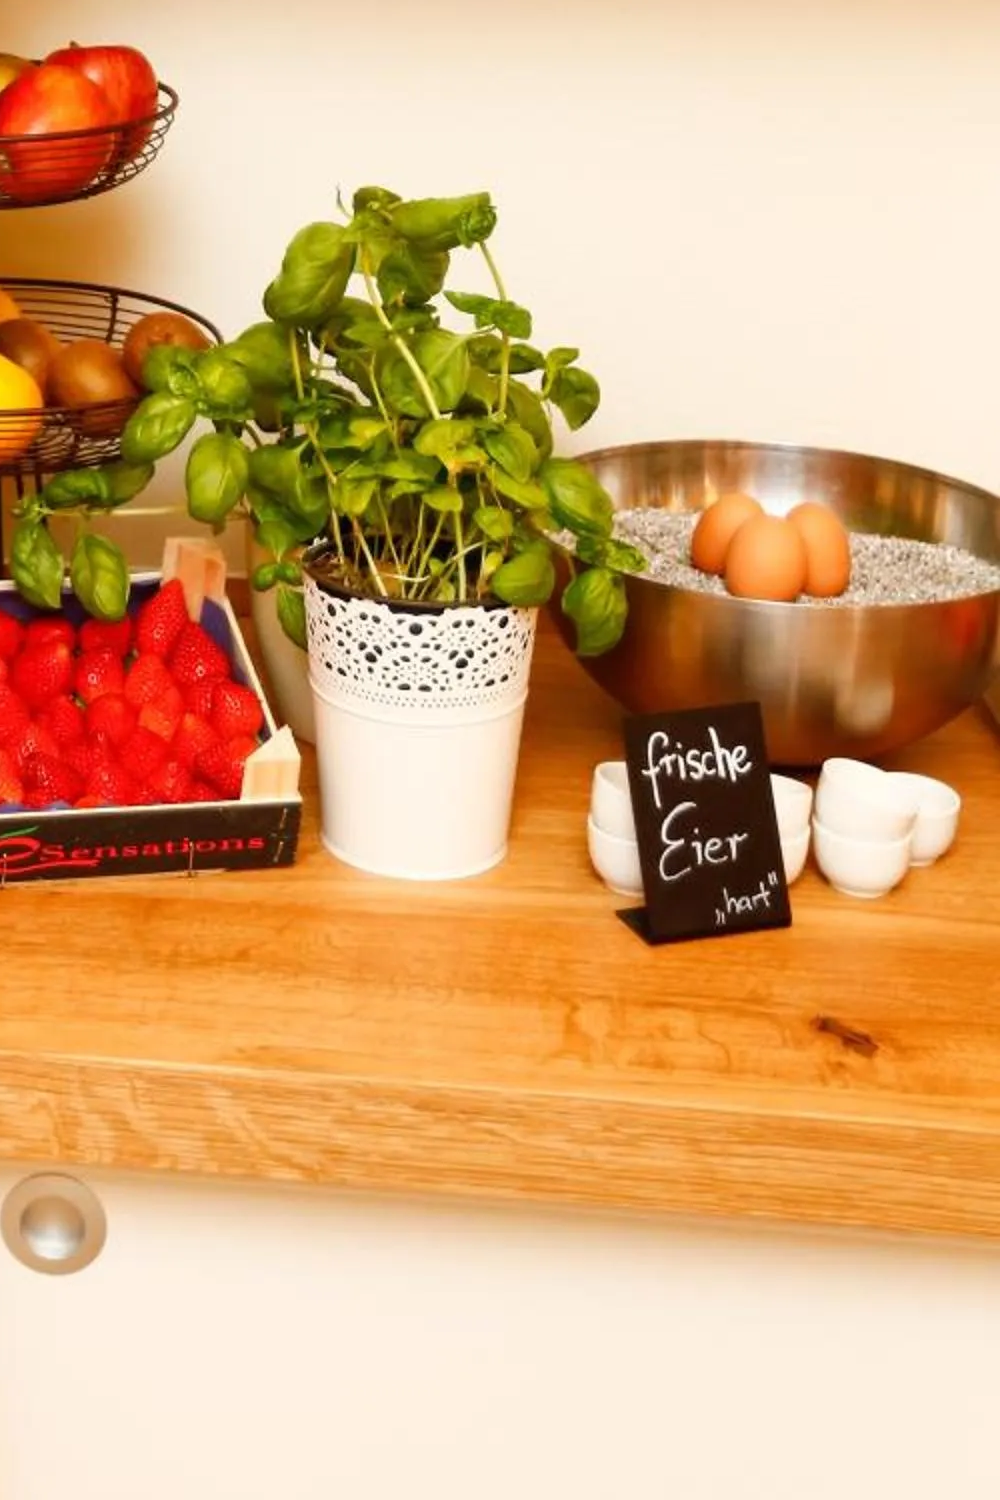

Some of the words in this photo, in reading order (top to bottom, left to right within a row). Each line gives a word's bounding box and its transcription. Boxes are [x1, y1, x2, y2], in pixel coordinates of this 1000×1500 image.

[640, 726, 753, 809] frische
[39, 836, 266, 863] Sensations
[658, 801, 749, 882] Eier
